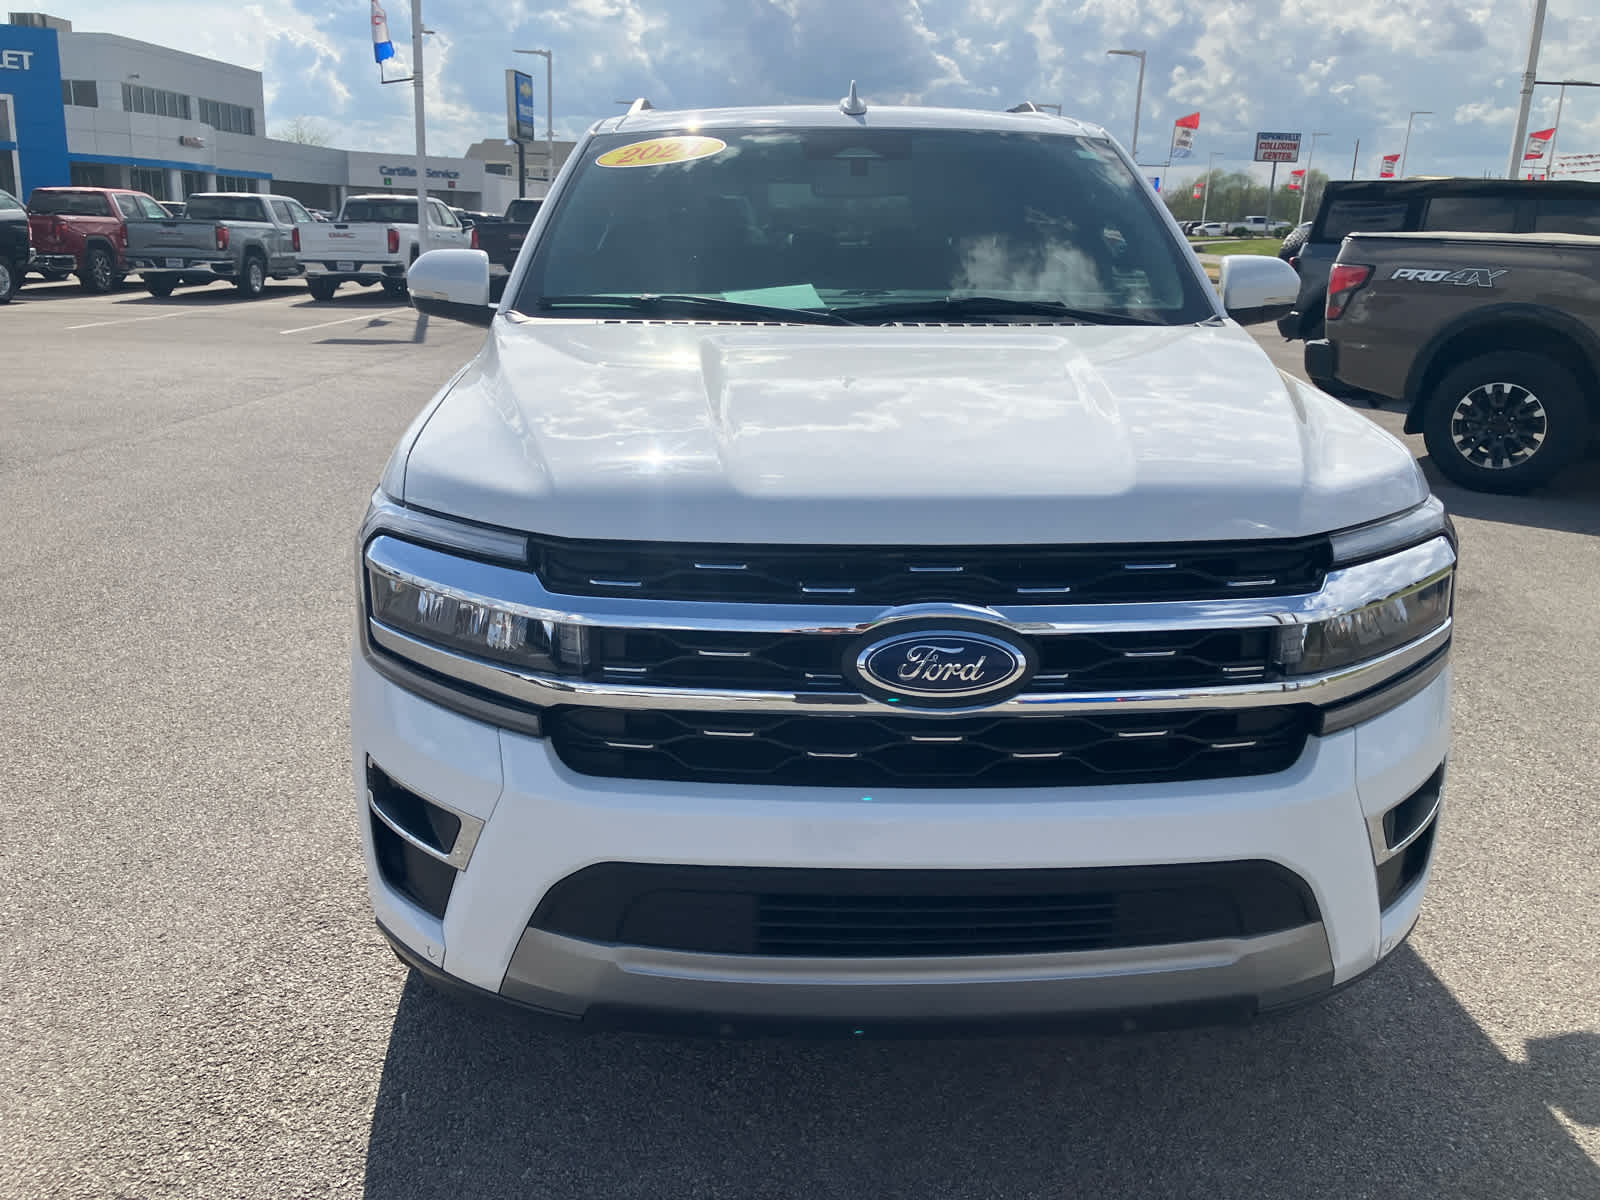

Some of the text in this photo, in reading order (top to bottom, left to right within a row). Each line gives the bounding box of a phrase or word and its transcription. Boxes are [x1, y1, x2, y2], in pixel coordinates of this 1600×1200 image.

[1259, 142, 1298, 151] COLLISION
[1263, 151, 1293, 160] CENTER
[379, 165, 460, 179] Certifie Service
[897, 645, 987, 681] Ford
